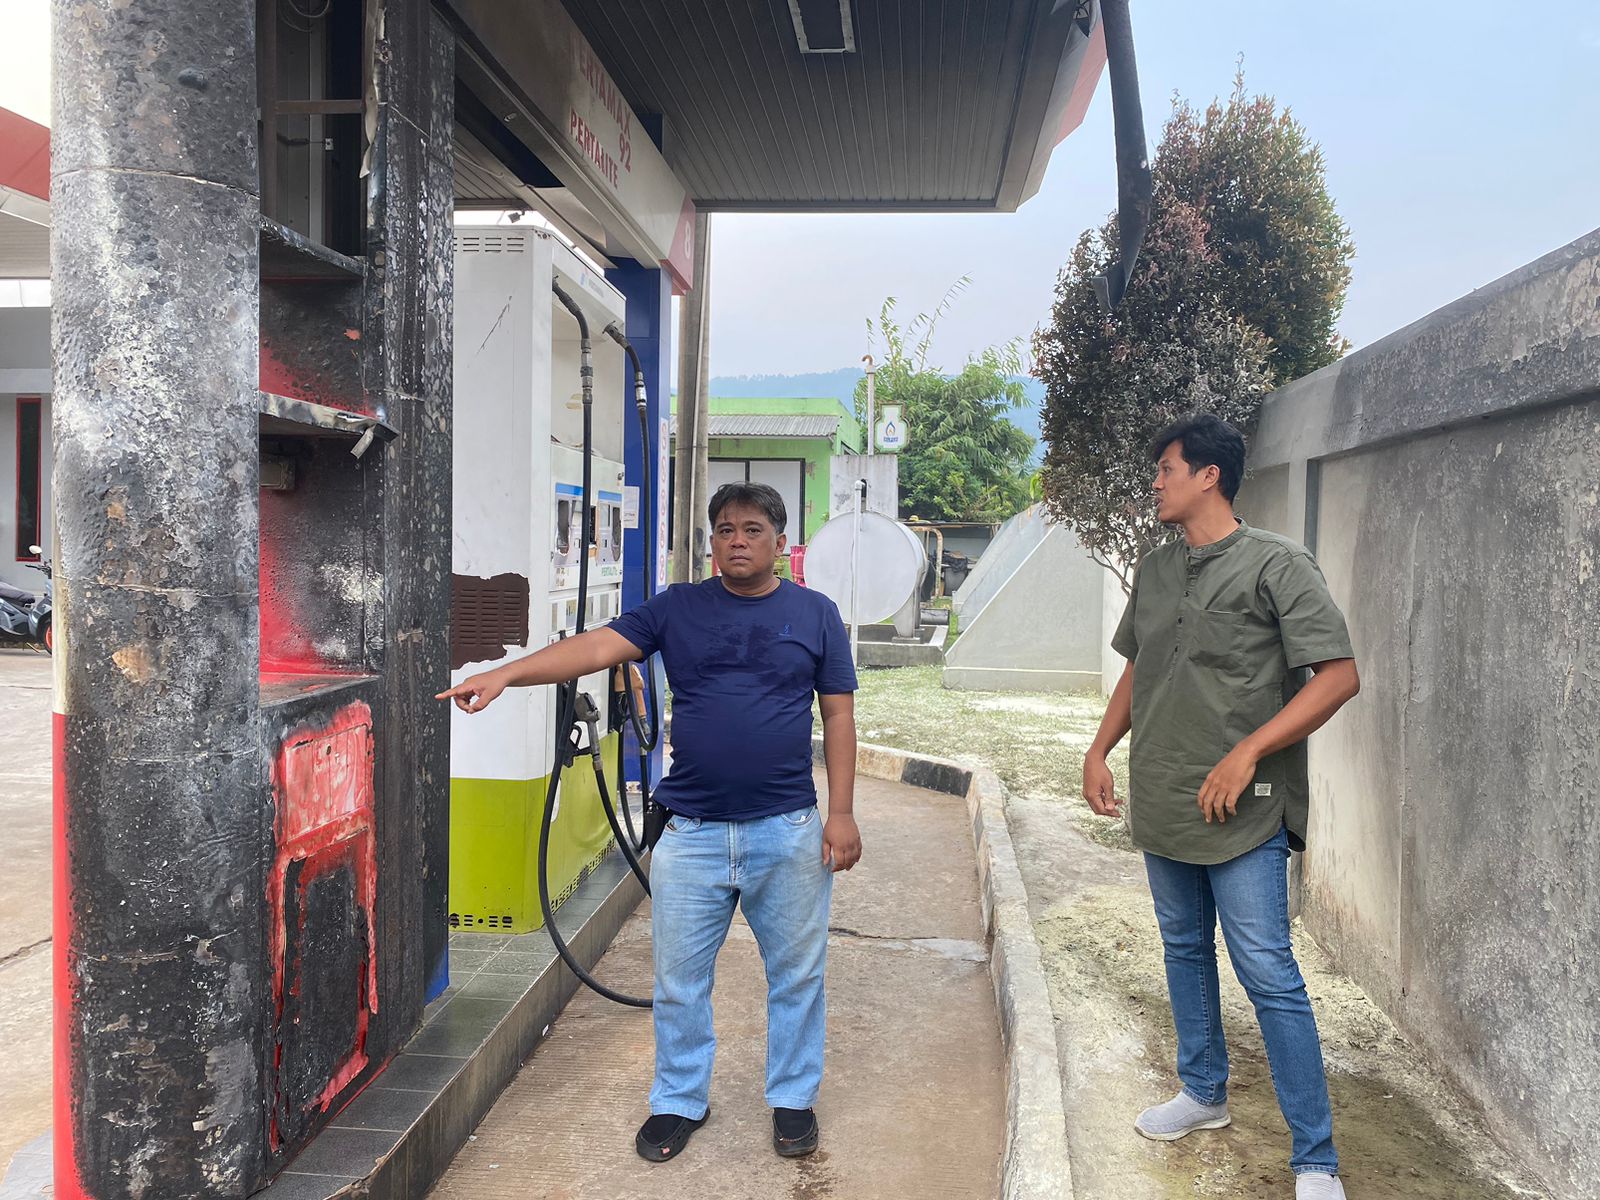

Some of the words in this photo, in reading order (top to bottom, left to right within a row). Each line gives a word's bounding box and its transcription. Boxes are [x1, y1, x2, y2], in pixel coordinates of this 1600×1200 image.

[569, 106, 619, 190] PERTALITE
[618, 132, 632, 174] 92
[684, 220, 692, 260] 8
